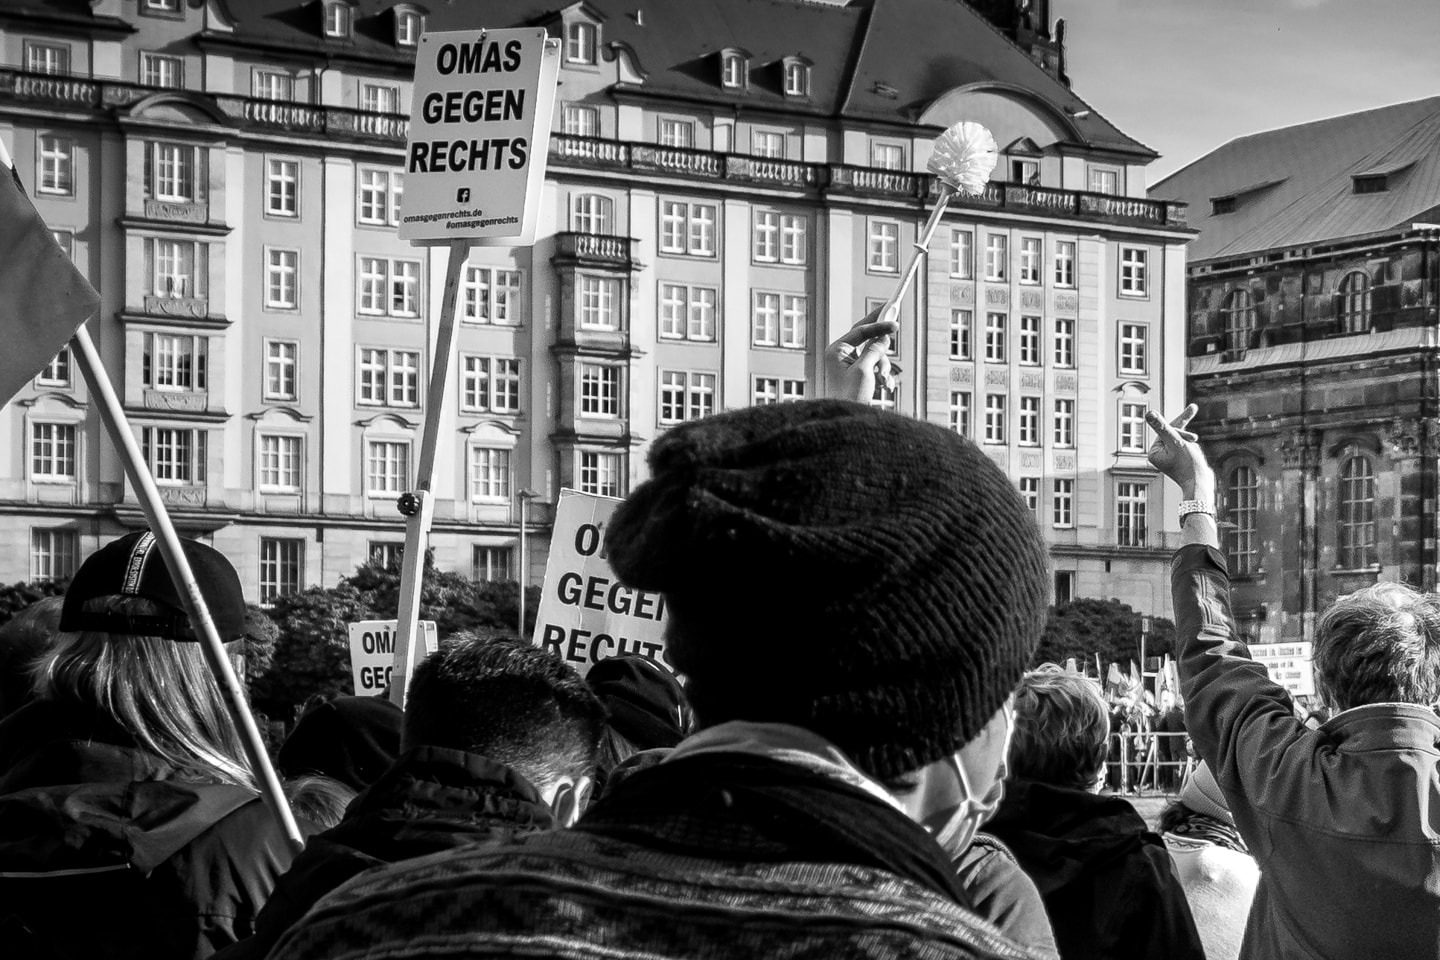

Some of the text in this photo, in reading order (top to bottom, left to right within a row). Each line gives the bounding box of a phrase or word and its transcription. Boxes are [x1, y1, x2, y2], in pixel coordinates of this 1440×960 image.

[436, 40, 522, 75] OMAS
[422, 89, 525, 124] GEGEN
[409, 137, 527, 173] RECHTS
[542, 624, 664, 664] RECHT
